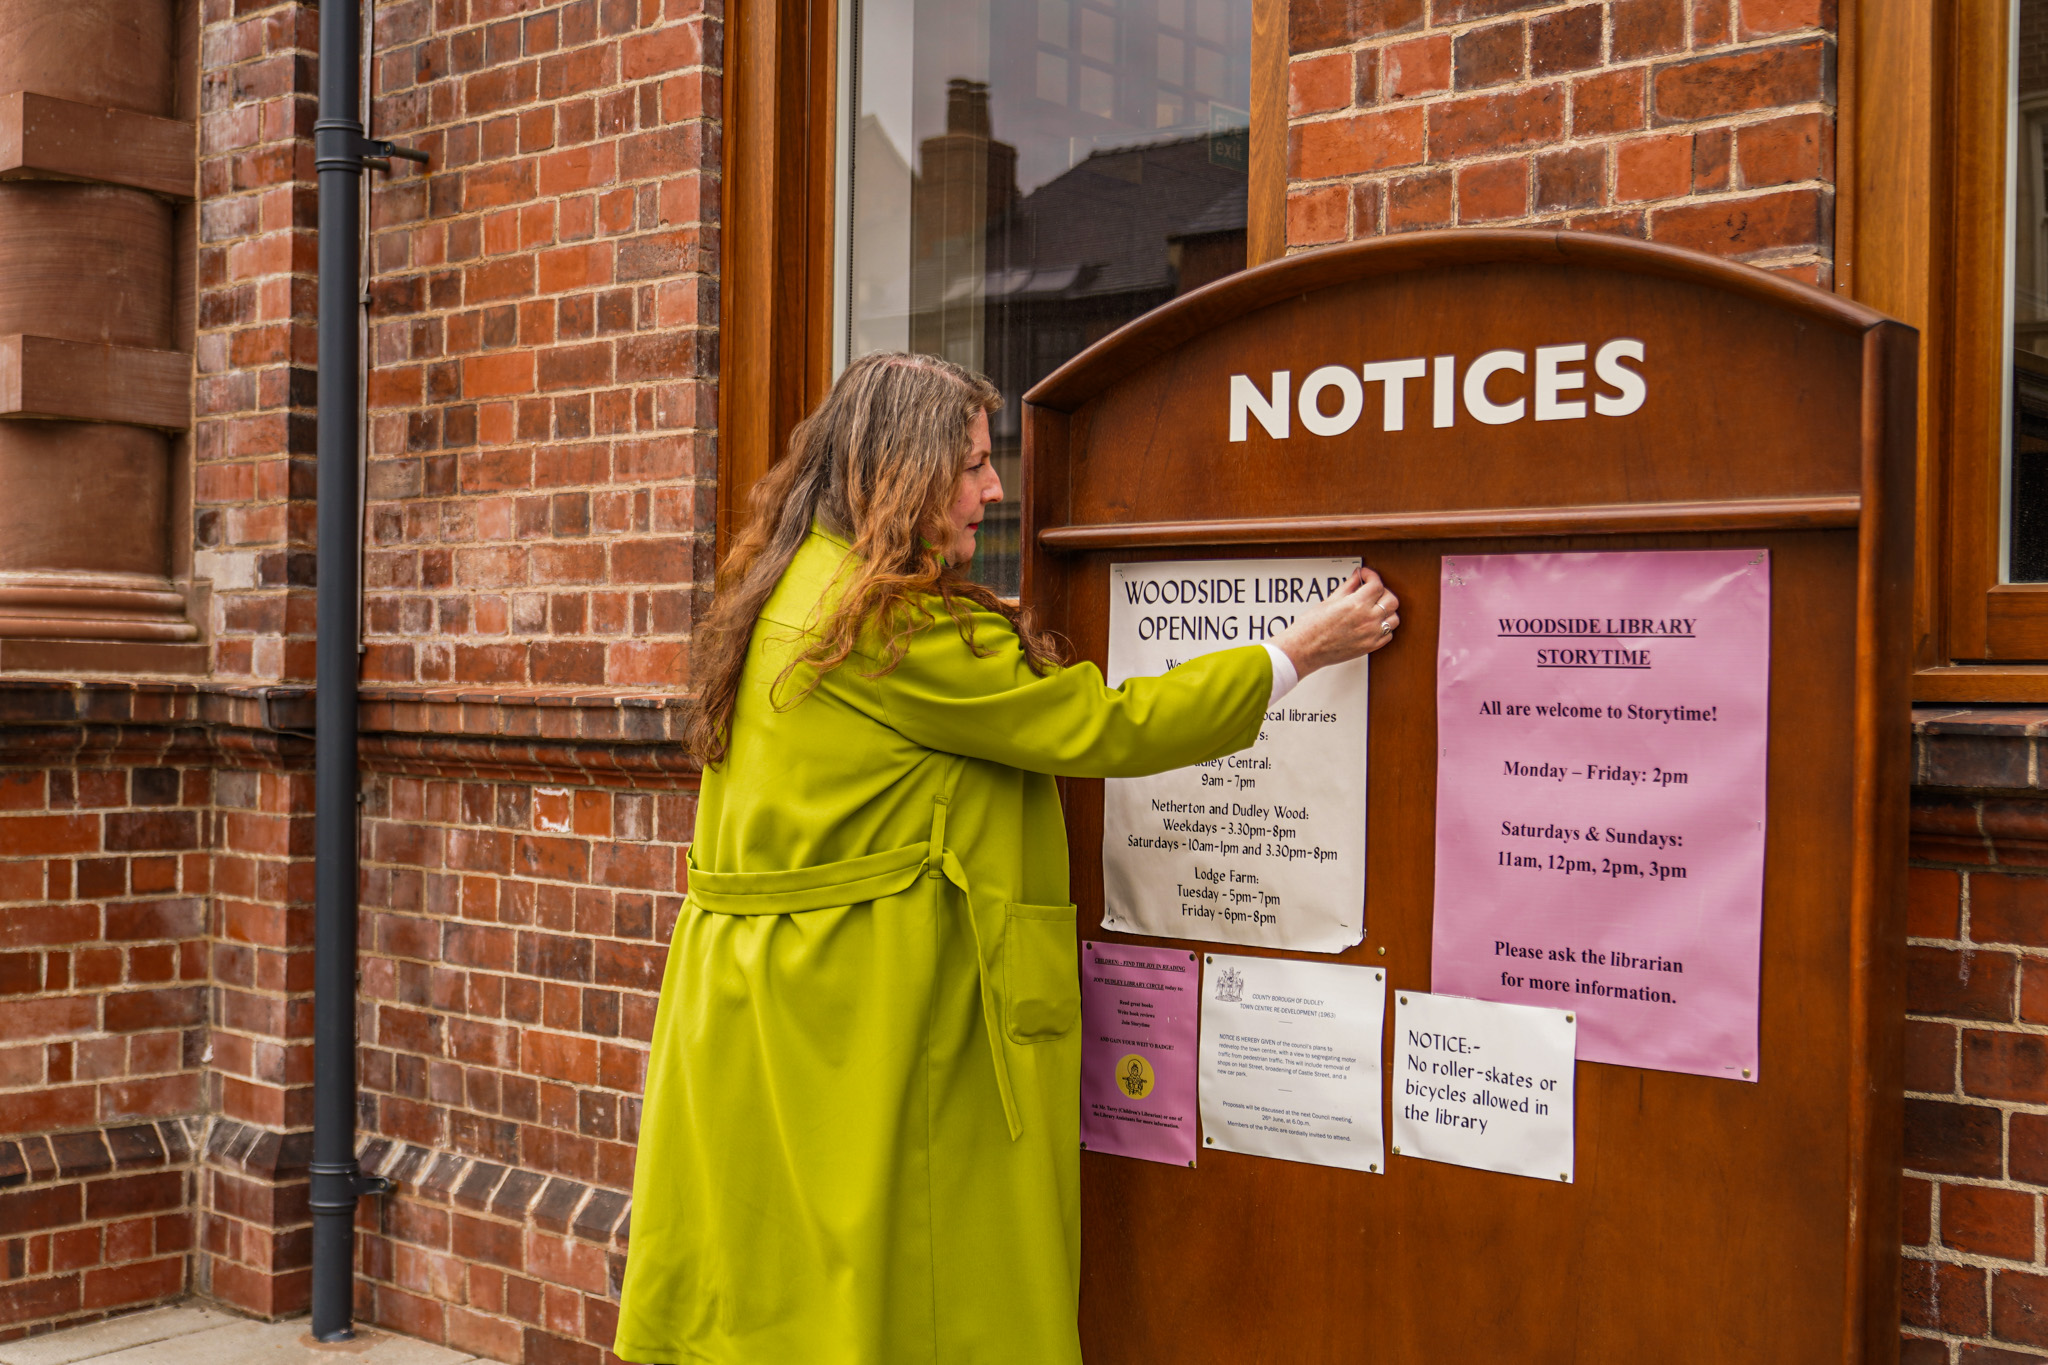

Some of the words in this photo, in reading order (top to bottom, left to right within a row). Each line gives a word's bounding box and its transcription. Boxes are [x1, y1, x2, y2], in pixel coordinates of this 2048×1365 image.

[1216, 140, 1242, 162] exit
[1229, 337, 1647, 442] NOTICES
[1125, 578, 1245, 605] WOODSIDE
[1138, 616, 1238, 641] OPENING
[1498, 618, 1601, 634] WOODSIDE
[1606, 618, 1697, 634] LIBRARY
[1537, 648, 1651, 666] STORYTIME
[1264, 708, 1284, 721] ocal
[1289, 708, 1337, 723] libraries
[1479, 700, 1502, 715] All
[1506, 704, 1531, 716] are
[1535, 702, 1602, 719] welcome
[1607, 705, 1623, 719] to
[1627, 703, 1717, 725] Storytime!
[1227, 755, 1271, 770] Central:
[1503, 760, 1568, 782] Monday
[1587, 764, 1647, 786] Friday:
[1652, 767, 1688, 788] 2pm
[1201, 773, 1224, 787] 9am
[1234, 774, 1255, 792] 7pm
[1152, 798, 1205, 814] Netherton
[1209, 802, 1229, 816] and
[1232, 803, 1270, 821] Dudley
[1274, 805, 1309, 820] Wood:
[1163, 818, 1217, 837] Weekdays
[1501, 820, 1580, 844] Saturdays
[1585, 826, 1600, 842] &
[1605, 827, 1683, 850] Sundays:
[1128, 834, 1179, 852] Saturdays
[1242, 842, 1262, 856] and
[1265, 843, 1337, 864] 3.30pm-8pm
[1194, 866, 1226, 885] Lodge
[1230, 869, 1259, 884] Farm:
[1498, 851, 1542, 872] 11am,
[1548, 854, 1597, 875] 12pm,
[1602, 858, 1644, 879] 2pm,
[1649, 861, 1687, 881] 3pm
[1177, 884, 1219, 903] Tuesday
[1182, 903, 1215, 922] Friday
[1495, 940, 1543, 960] Please
[1548, 947, 1576, 963] ask
[1581, 948, 1606, 965] the
[1610, 951, 1683, 973] librarian
[1501, 971, 1524, 988] for
[1529, 978, 1570, 993] more
[1575, 978, 1676, 1004] information.
[1408, 1054, 1427, 1073] No
[1433, 1060, 1533, 1089] roller-skates
[1540, 1078, 1557, 1092] or
[1405, 1078, 1466, 1103] bicycles
[1472, 1089, 1529, 1113] allowed
[1536, 1099, 1548, 1116] in
[1405, 1103, 1429, 1122] the
[1435, 1107, 1488, 1135] library
